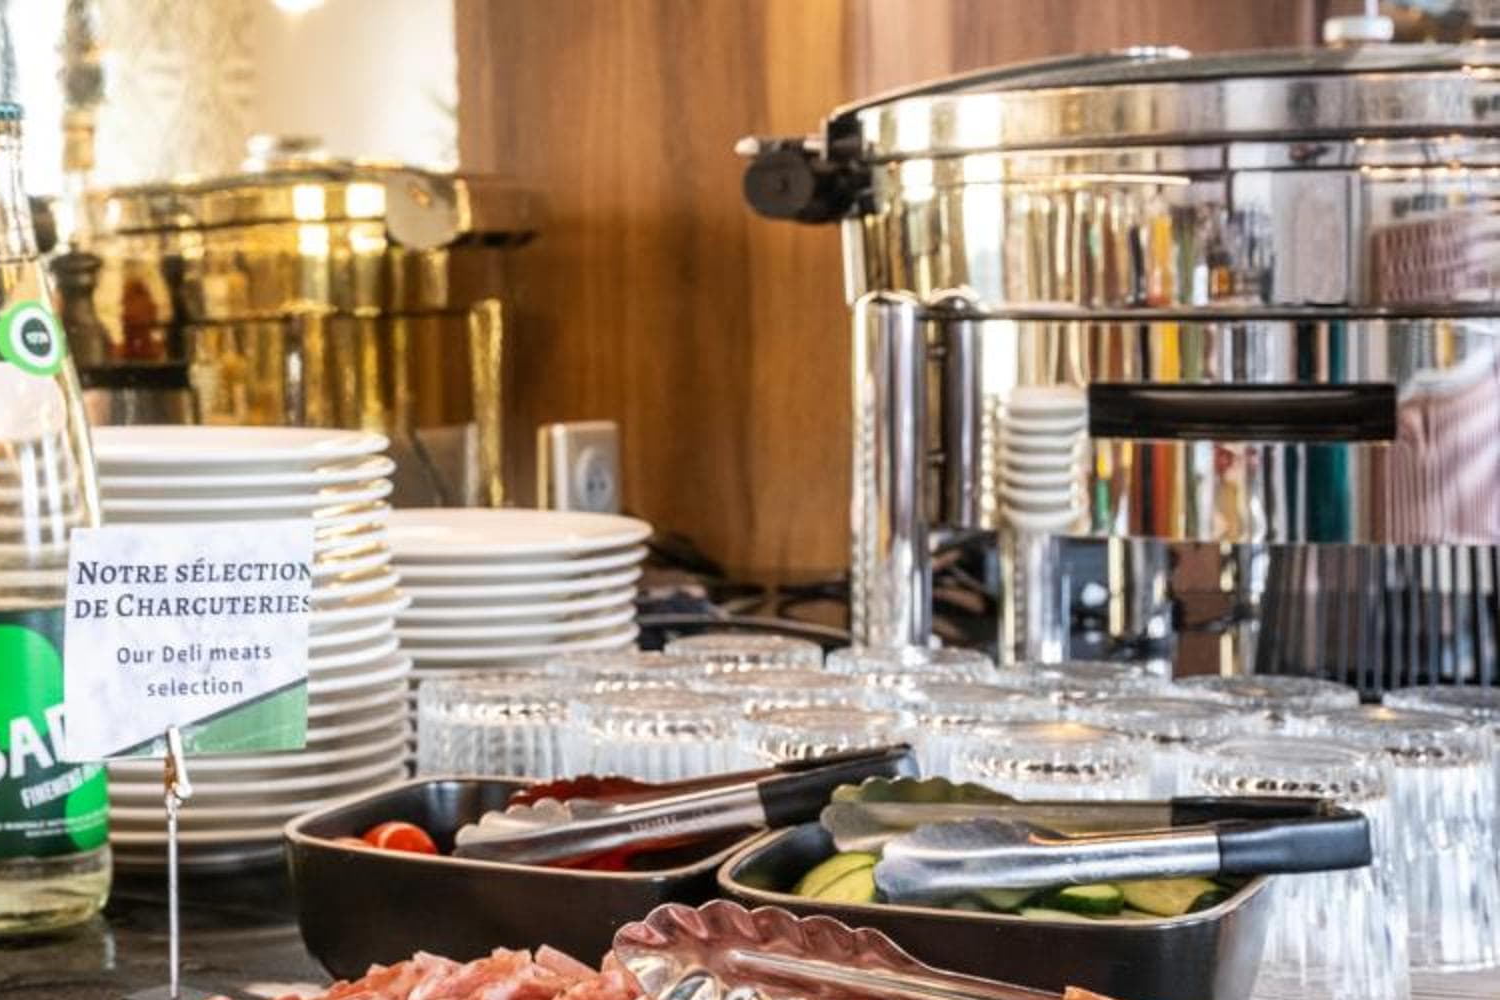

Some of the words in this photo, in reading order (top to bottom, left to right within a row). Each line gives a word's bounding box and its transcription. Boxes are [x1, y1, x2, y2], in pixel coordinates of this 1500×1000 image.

[76, 560, 168, 585] NOTRE
[74, 599, 109, 619] DE
[116, 647, 154, 665] Our
[162, 643, 202, 663] Deli
[209, 643, 273, 662] meats
[147, 678, 244, 697] selection
